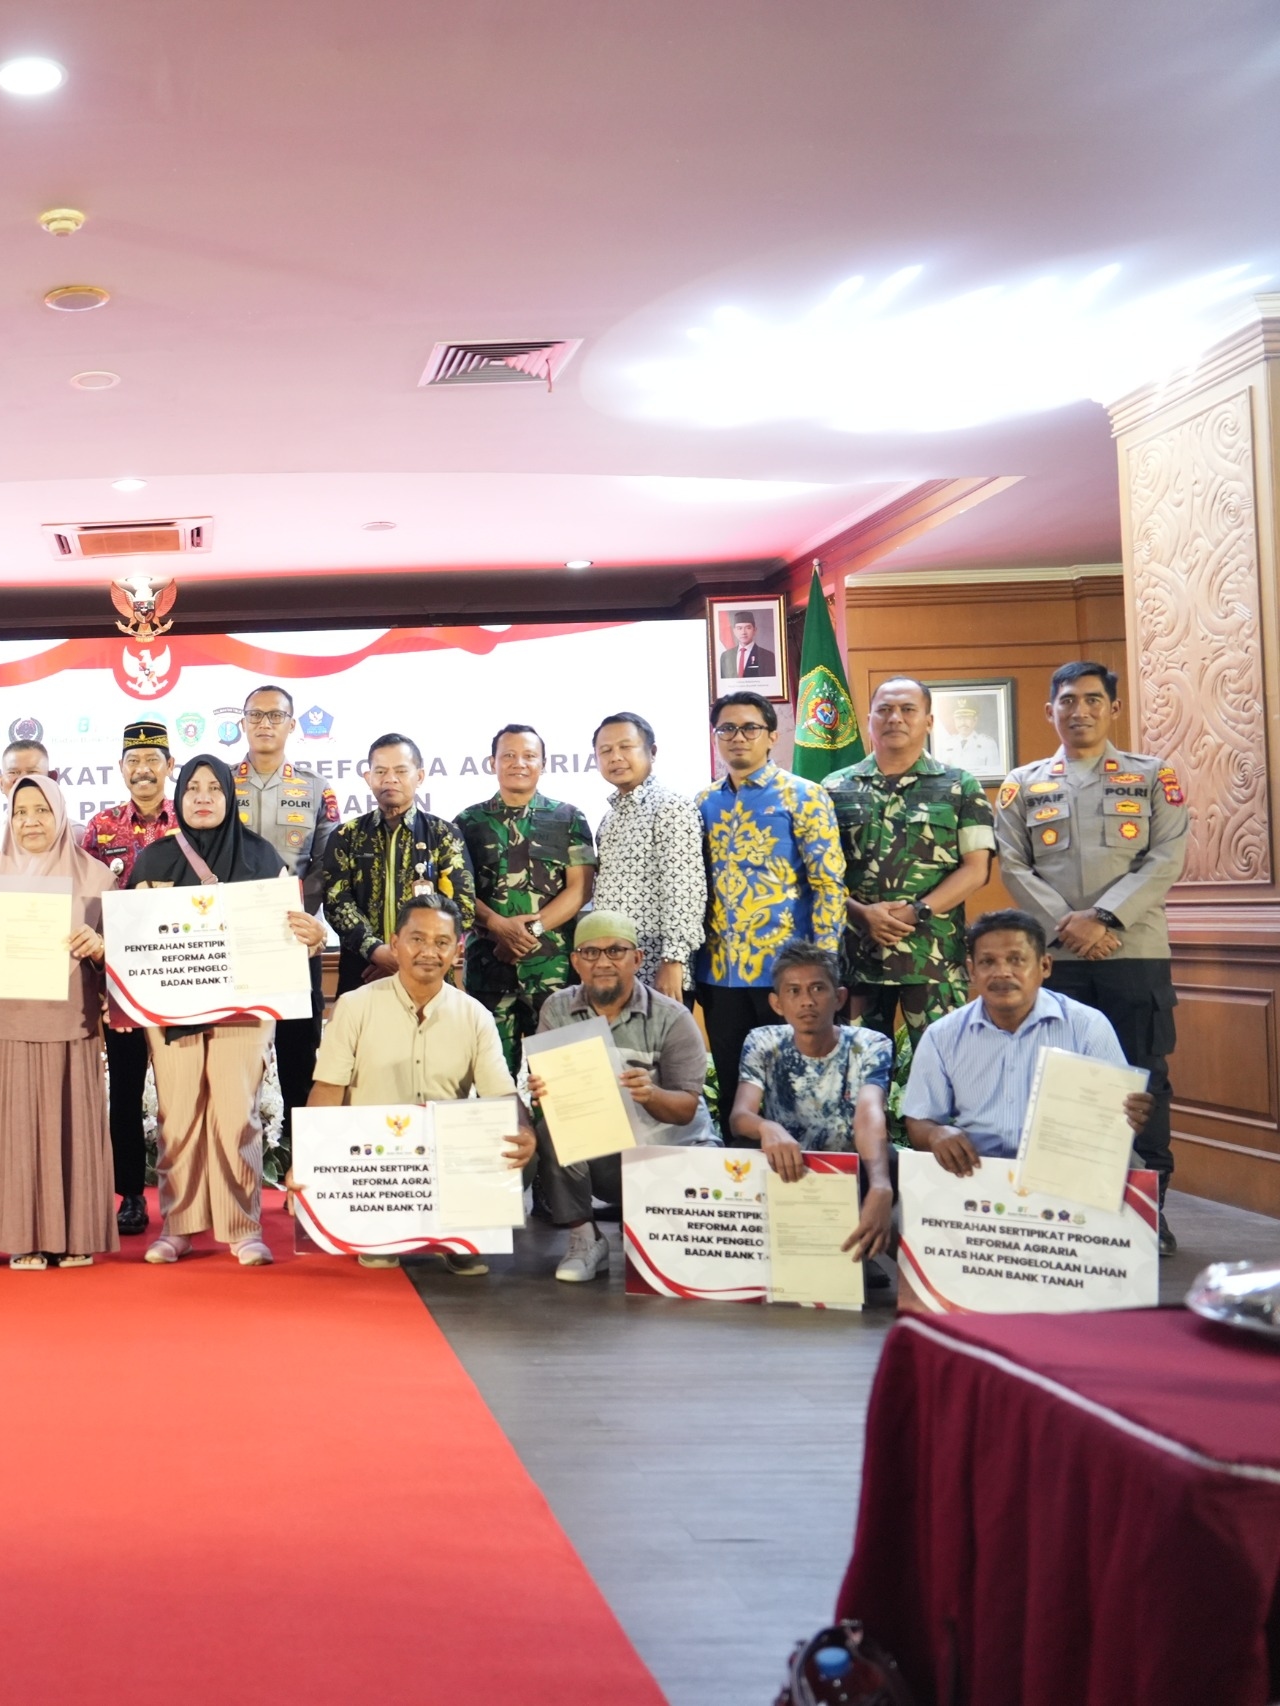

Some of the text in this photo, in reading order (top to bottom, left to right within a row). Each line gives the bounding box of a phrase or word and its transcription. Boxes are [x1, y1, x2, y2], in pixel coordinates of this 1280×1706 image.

[1105, 787, 1148, 797] POLRI
[281, 799, 311, 808] POLRI
[124, 940, 226, 953] PENYERAHAN SERTIPIK
[161, 953, 206, 962] REFORMA
[128, 964, 229, 977] DI ATAS HAK PENGELO
[160, 979, 194, 987] BADAN
[195, 977, 221, 985] BANK
[313, 1164, 430, 1174] PENYERAHAN SERTIPIKA
[352, 1177, 432, 1186] REFORMA AGRA
[328, 1191, 354, 1199] ATAS
[379, 1190, 432, 1198] PENGELOL
[350, 1204, 385, 1212] BADAN
[386, 1203, 415, 1212] BANK
[645, 1206, 763, 1220] PENYERAHAN SERTIPIK
[687, 1221, 738, 1232] REFORMA
[921, 1217, 1131, 1248] PENYERAHAN SERTIPIKAT PROGRAM
[649, 1232, 764, 1247] DI ATAS HAK PENGELO
[965, 1236, 1078, 1257] REFORMA AGRARIA
[684, 1248, 722, 1258] BADAN
[724, 1250, 755, 1260] BANK
[924, 1246, 1127, 1278] DI ATAS HAK PENGELOLAAN LAHAN
[962, 1265, 1084, 1288] BADAN BANK TANAH
